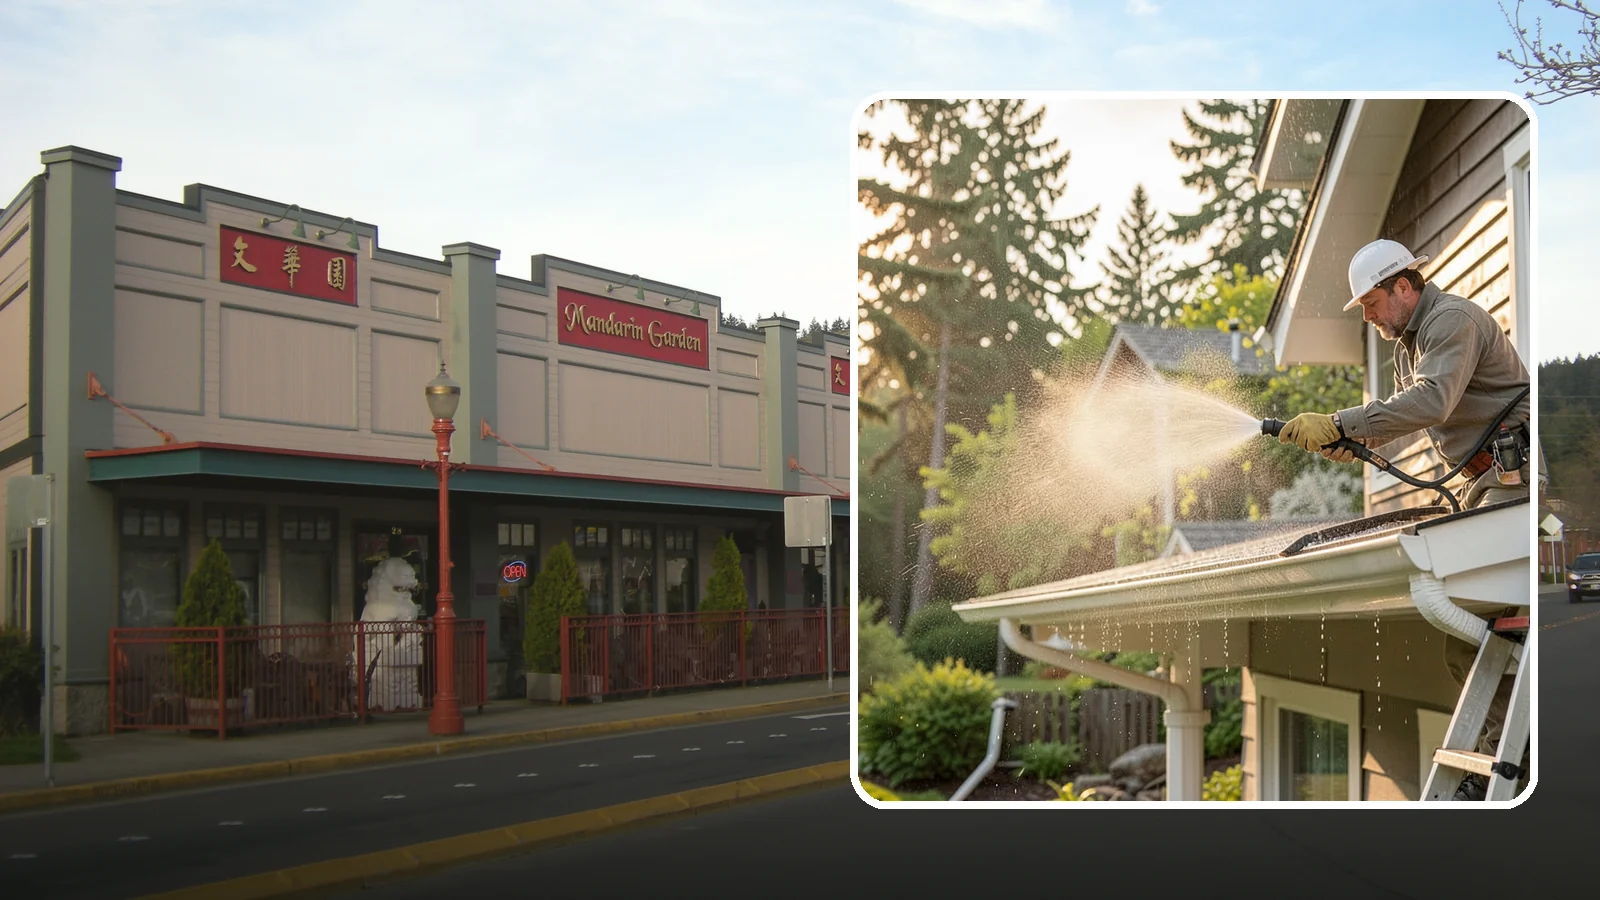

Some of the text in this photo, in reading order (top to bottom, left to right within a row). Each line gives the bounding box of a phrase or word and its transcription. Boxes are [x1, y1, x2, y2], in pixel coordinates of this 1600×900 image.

[231, 235, 346, 290] 文華園
[564, 302, 702, 352] Mandarin Garden
[503, 565, 527, 579] OPEN
